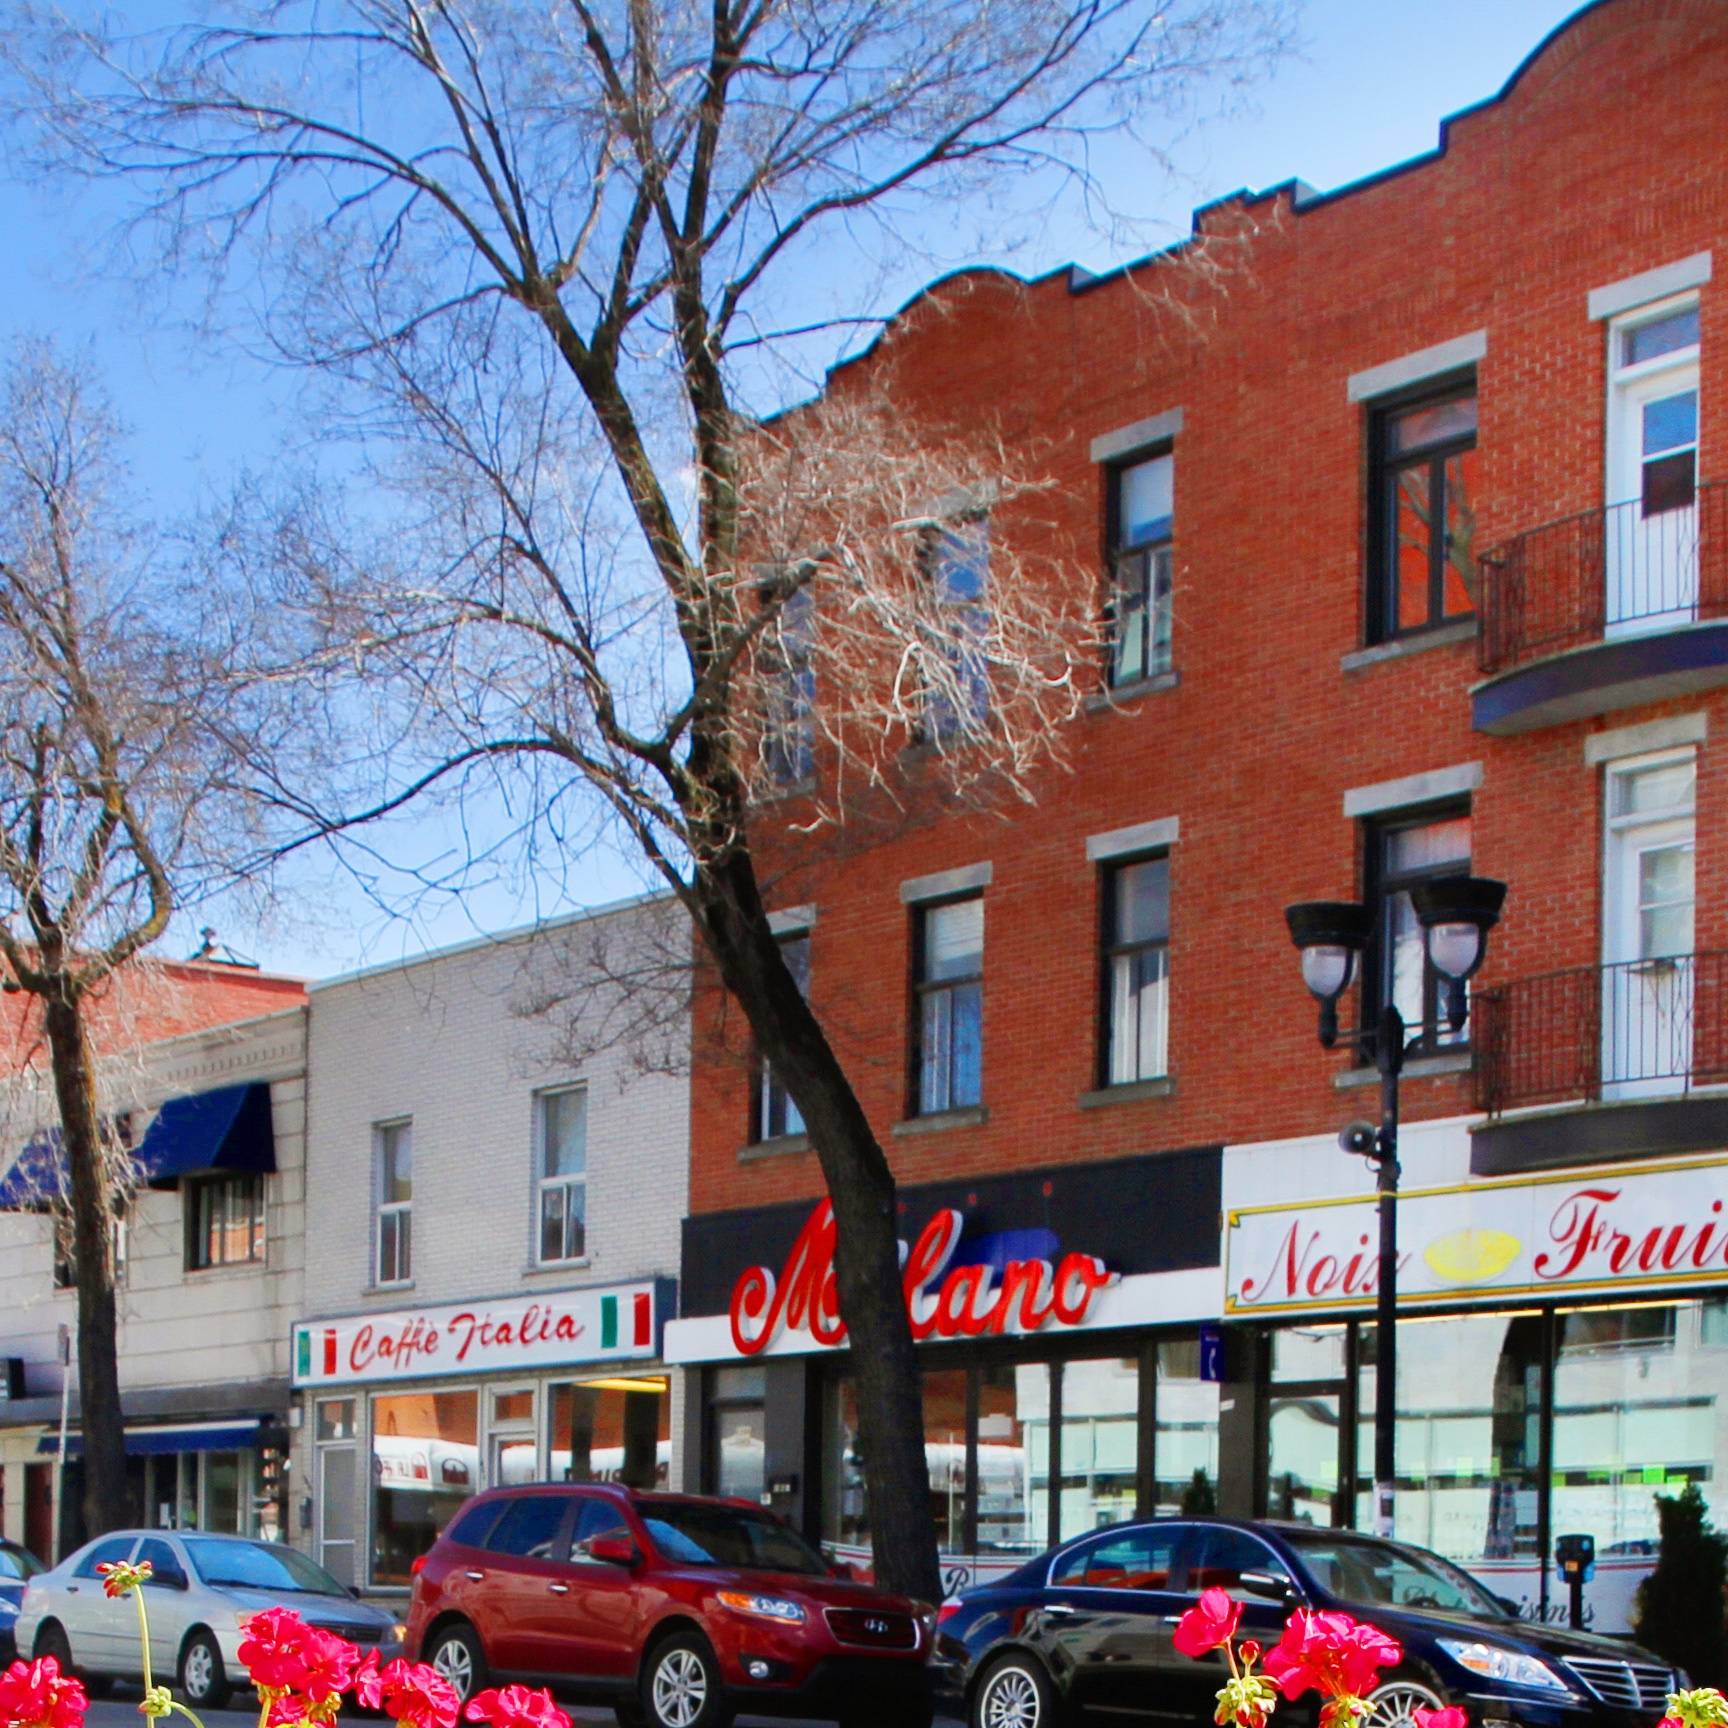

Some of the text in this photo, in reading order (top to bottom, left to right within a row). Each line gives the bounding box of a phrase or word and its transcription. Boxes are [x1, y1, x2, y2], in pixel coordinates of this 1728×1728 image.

[730, 1196, 1112, 1356] Mlano
[348, 1304, 586, 1372] Caffè Italia
